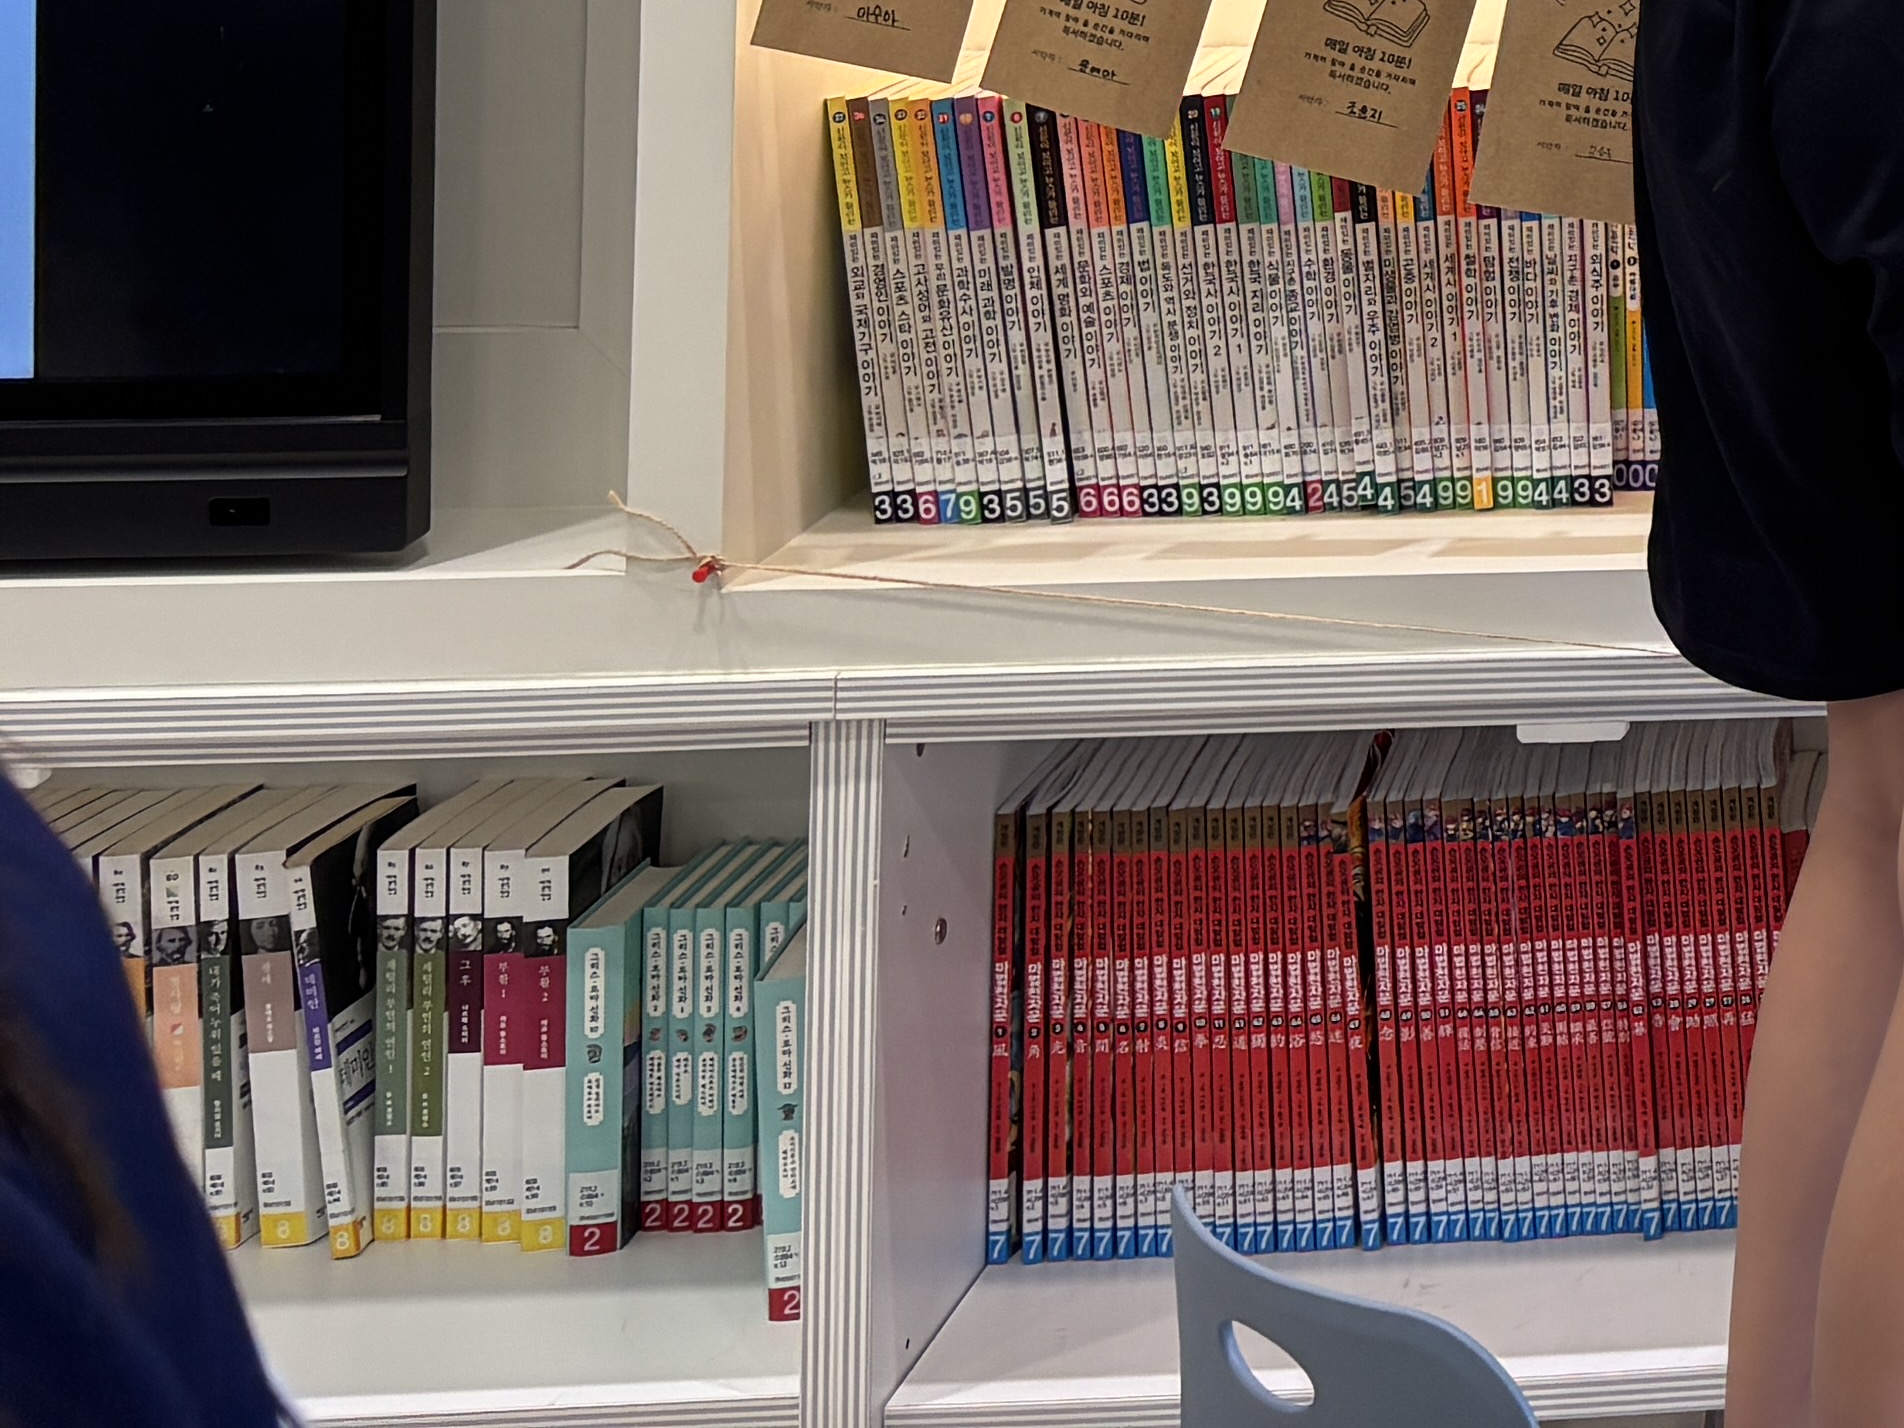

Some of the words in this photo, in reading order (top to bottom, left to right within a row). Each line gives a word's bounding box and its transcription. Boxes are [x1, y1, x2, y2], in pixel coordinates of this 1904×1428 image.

[873, 495, 889, 520] 3
[918, 495, 935, 519] 6
[940, 493, 955, 522] 7
[1004, 493, 1022, 515] 5
[583, 1228, 602, 1252] 2
[1027, 1233, 1043, 1259] 7
